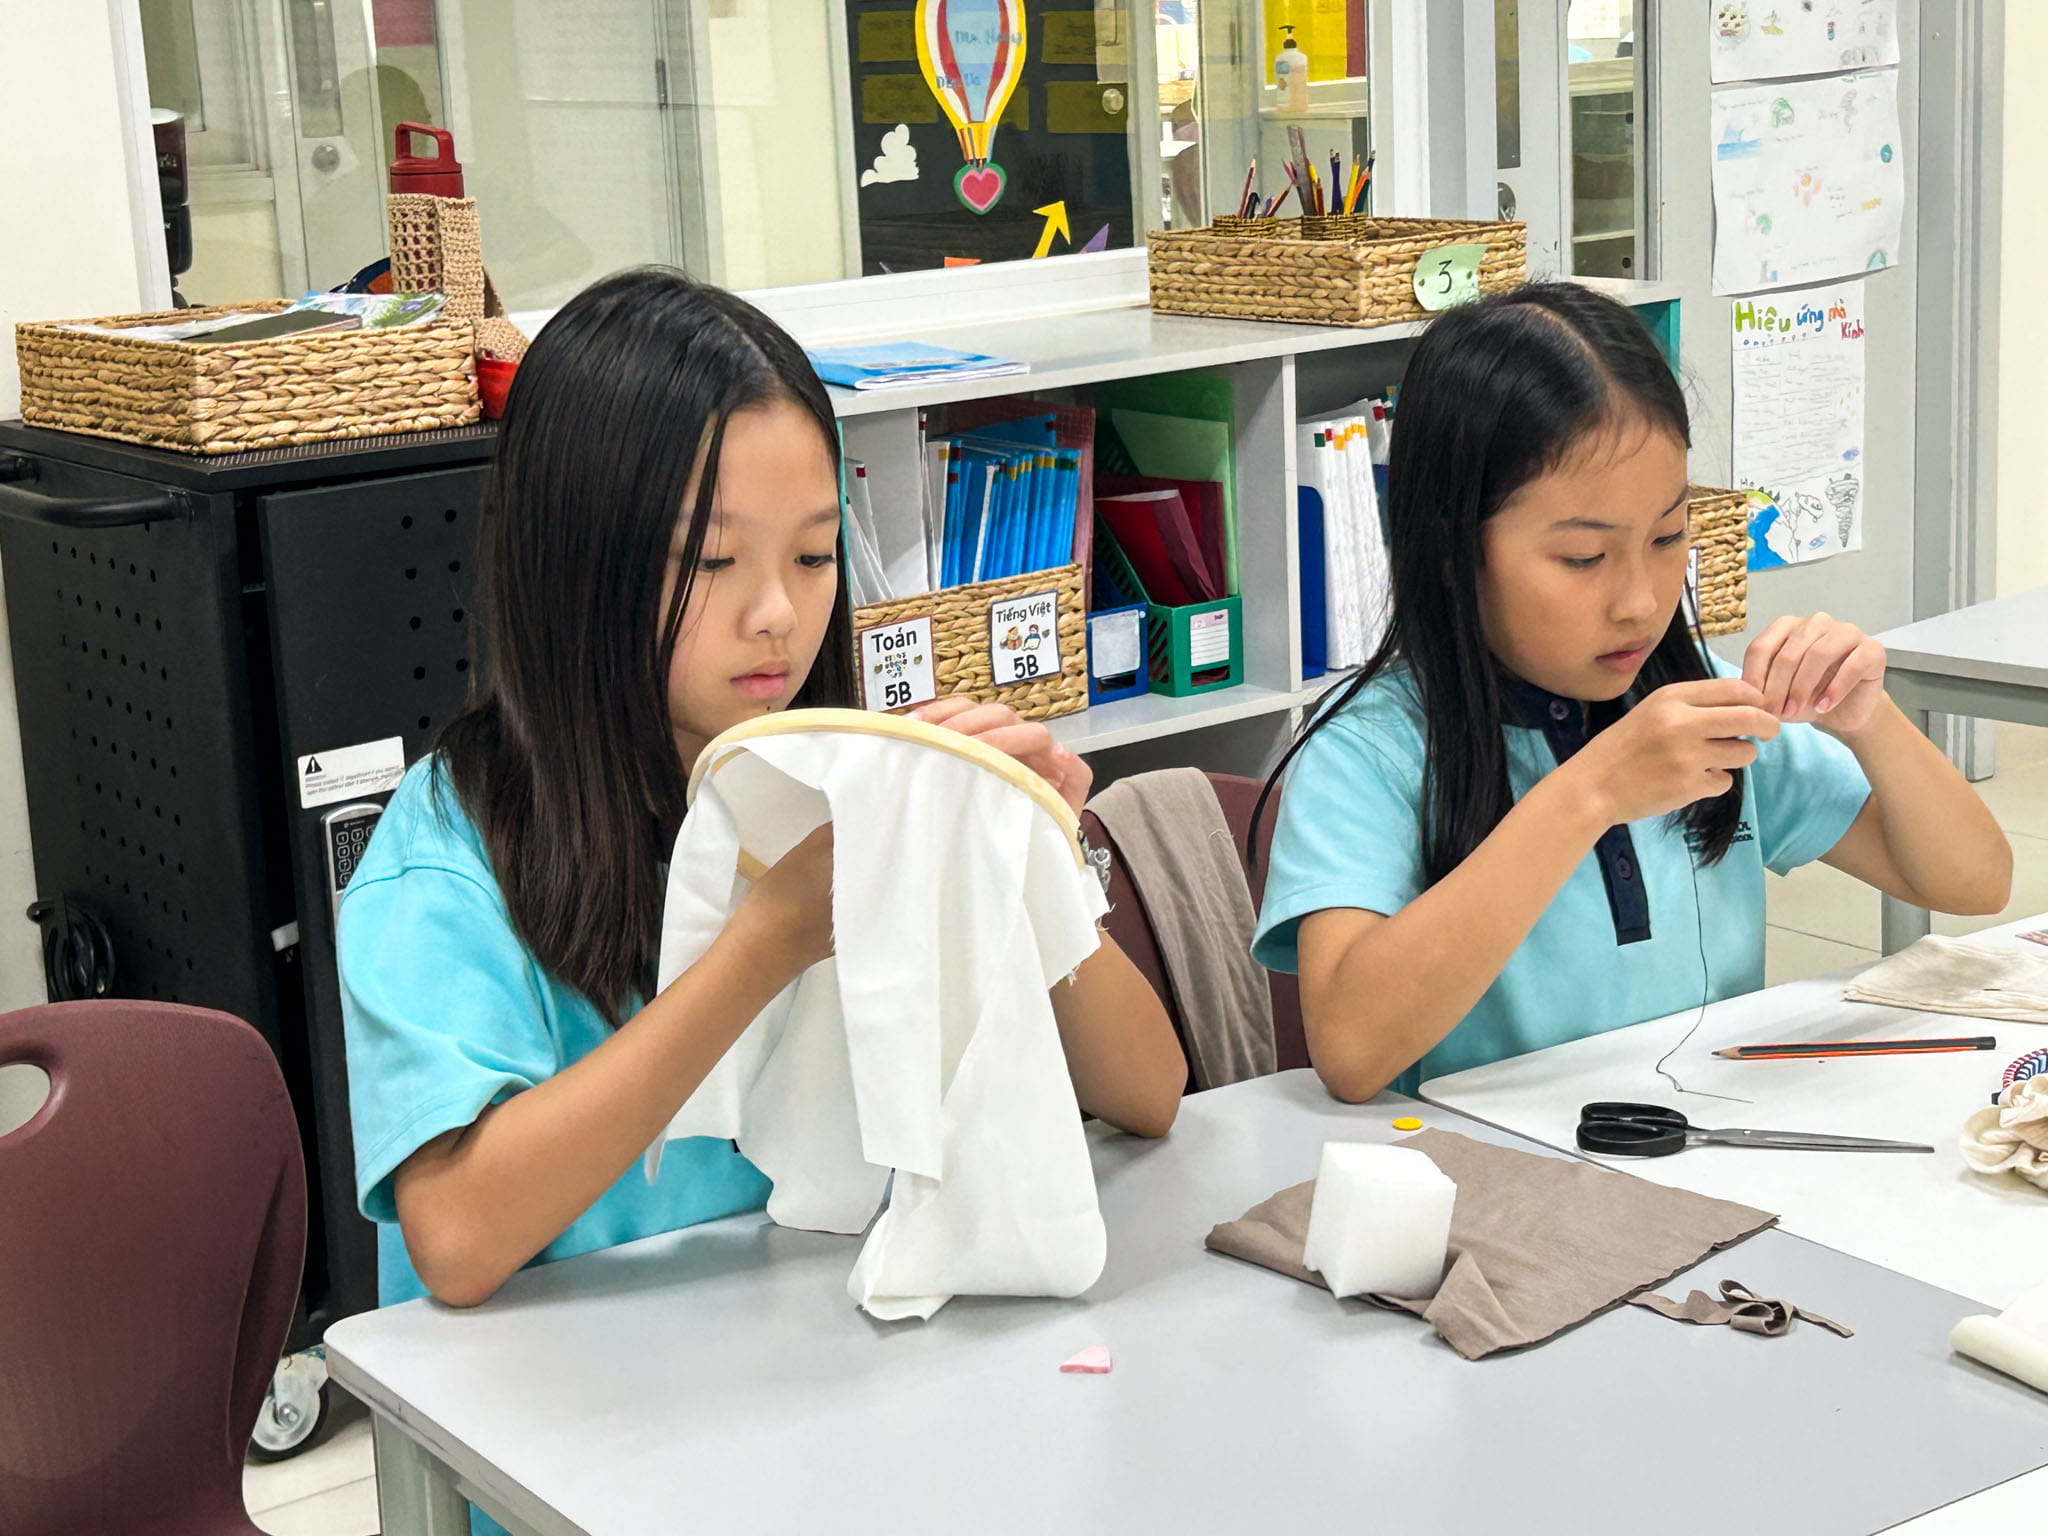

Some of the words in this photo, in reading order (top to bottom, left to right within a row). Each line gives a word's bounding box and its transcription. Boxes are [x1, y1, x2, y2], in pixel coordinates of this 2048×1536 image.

[1438, 260, 1452, 294] 3
[996, 607, 1027, 623] Tiếng
[1028, 601, 1051, 617] Việt
[871, 627, 917, 653] Toán
[1013, 654, 1039, 679] 5B
[885, 681, 912, 707] 5B
